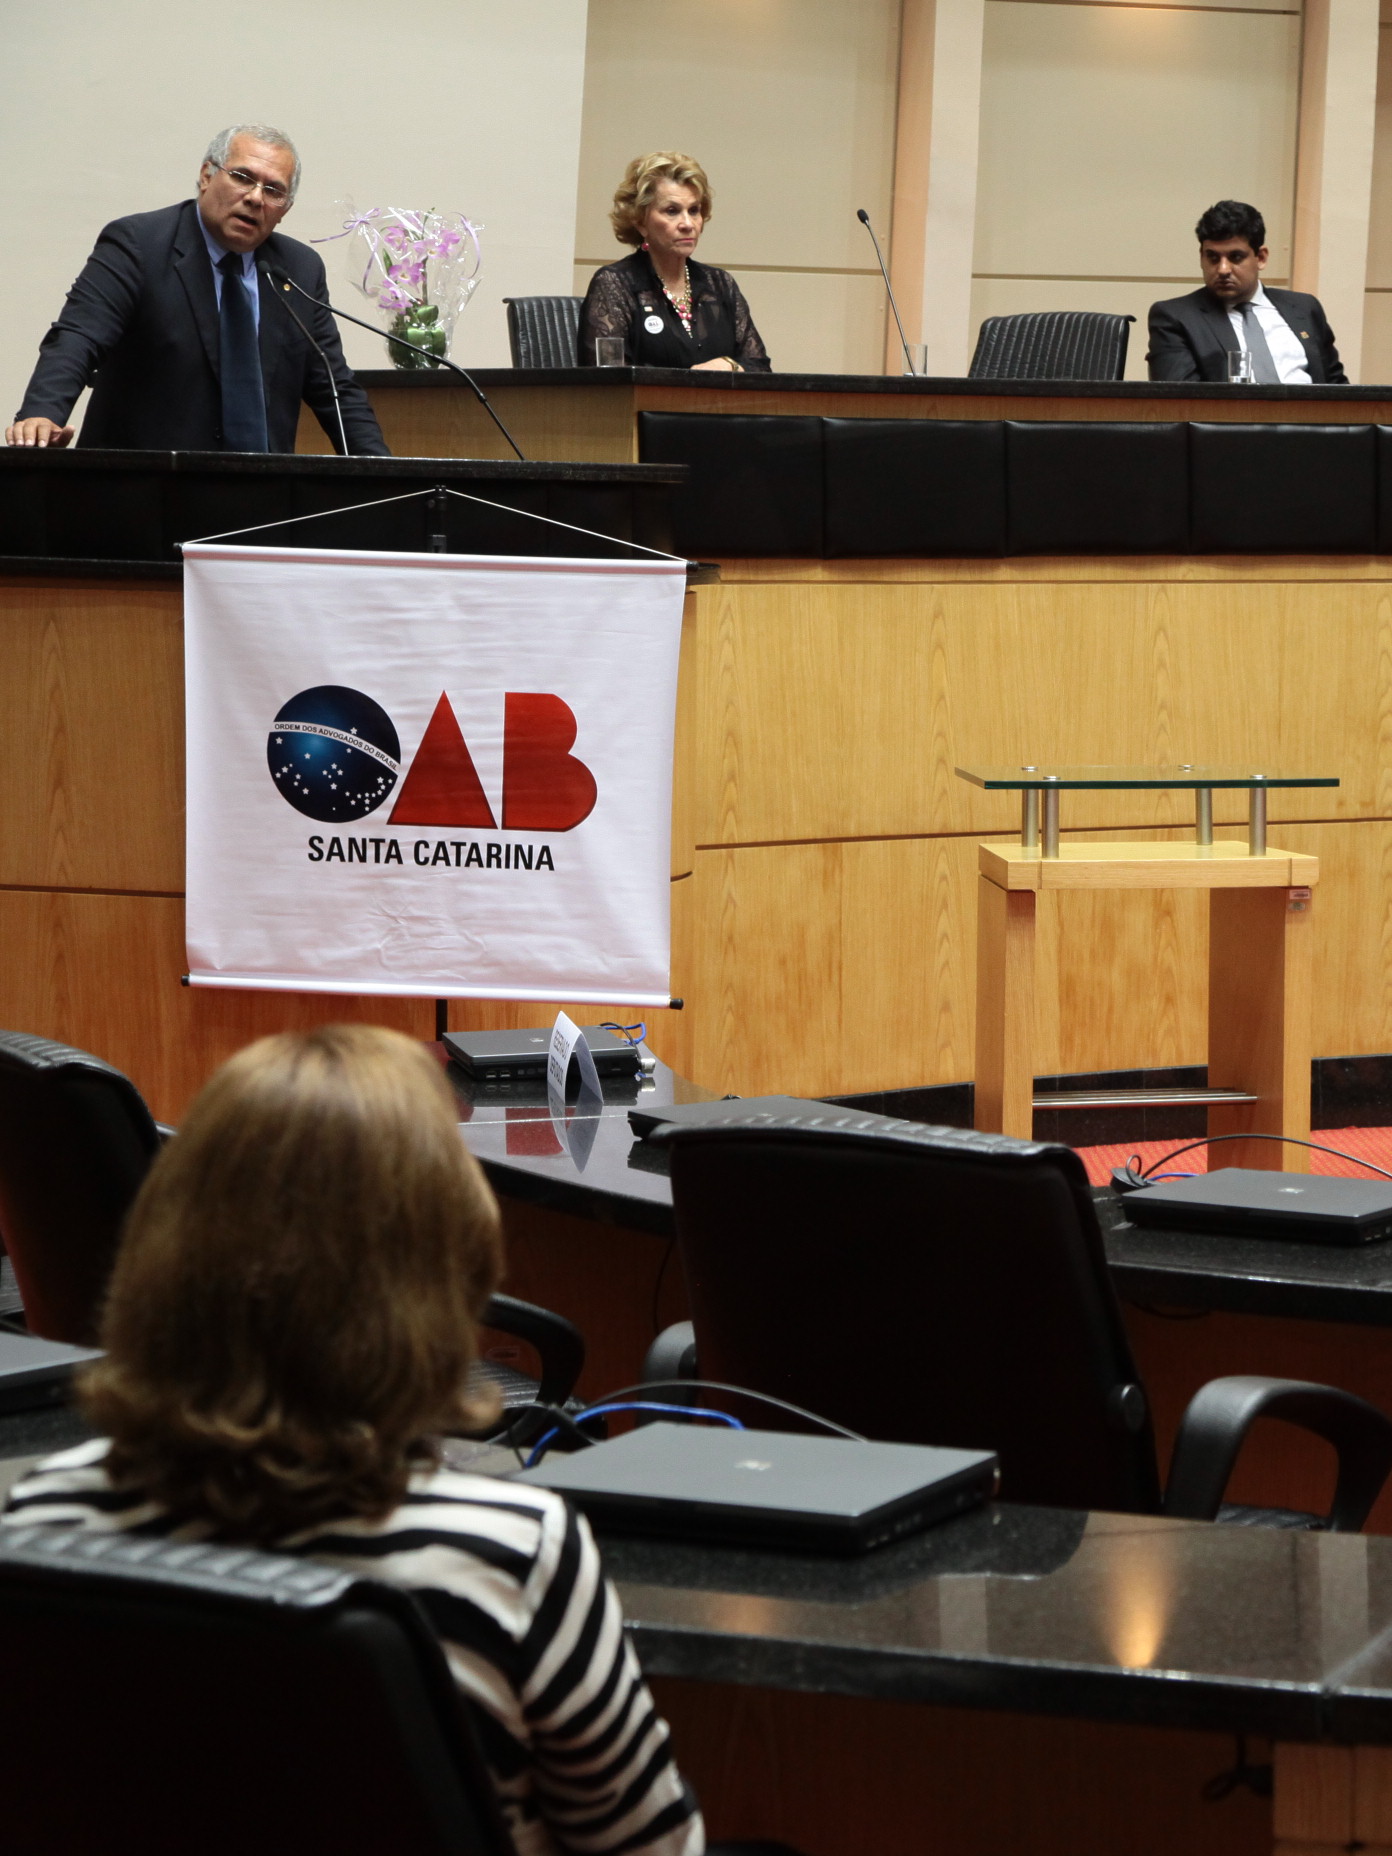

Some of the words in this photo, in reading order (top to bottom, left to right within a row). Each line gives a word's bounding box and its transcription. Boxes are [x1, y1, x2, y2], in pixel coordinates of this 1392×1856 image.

[267, 684, 598, 833] OAB
[274, 723, 301, 731] ORDEM
[302, 725, 318, 734] DOS
[318, 728, 363, 749] ADVOGADOS
[364, 744, 375, 755] DO
[375, 751, 397, 771] BRASIL
[307, 835, 404, 865] SANTA
[413, 839, 555, 871] CATARINA
